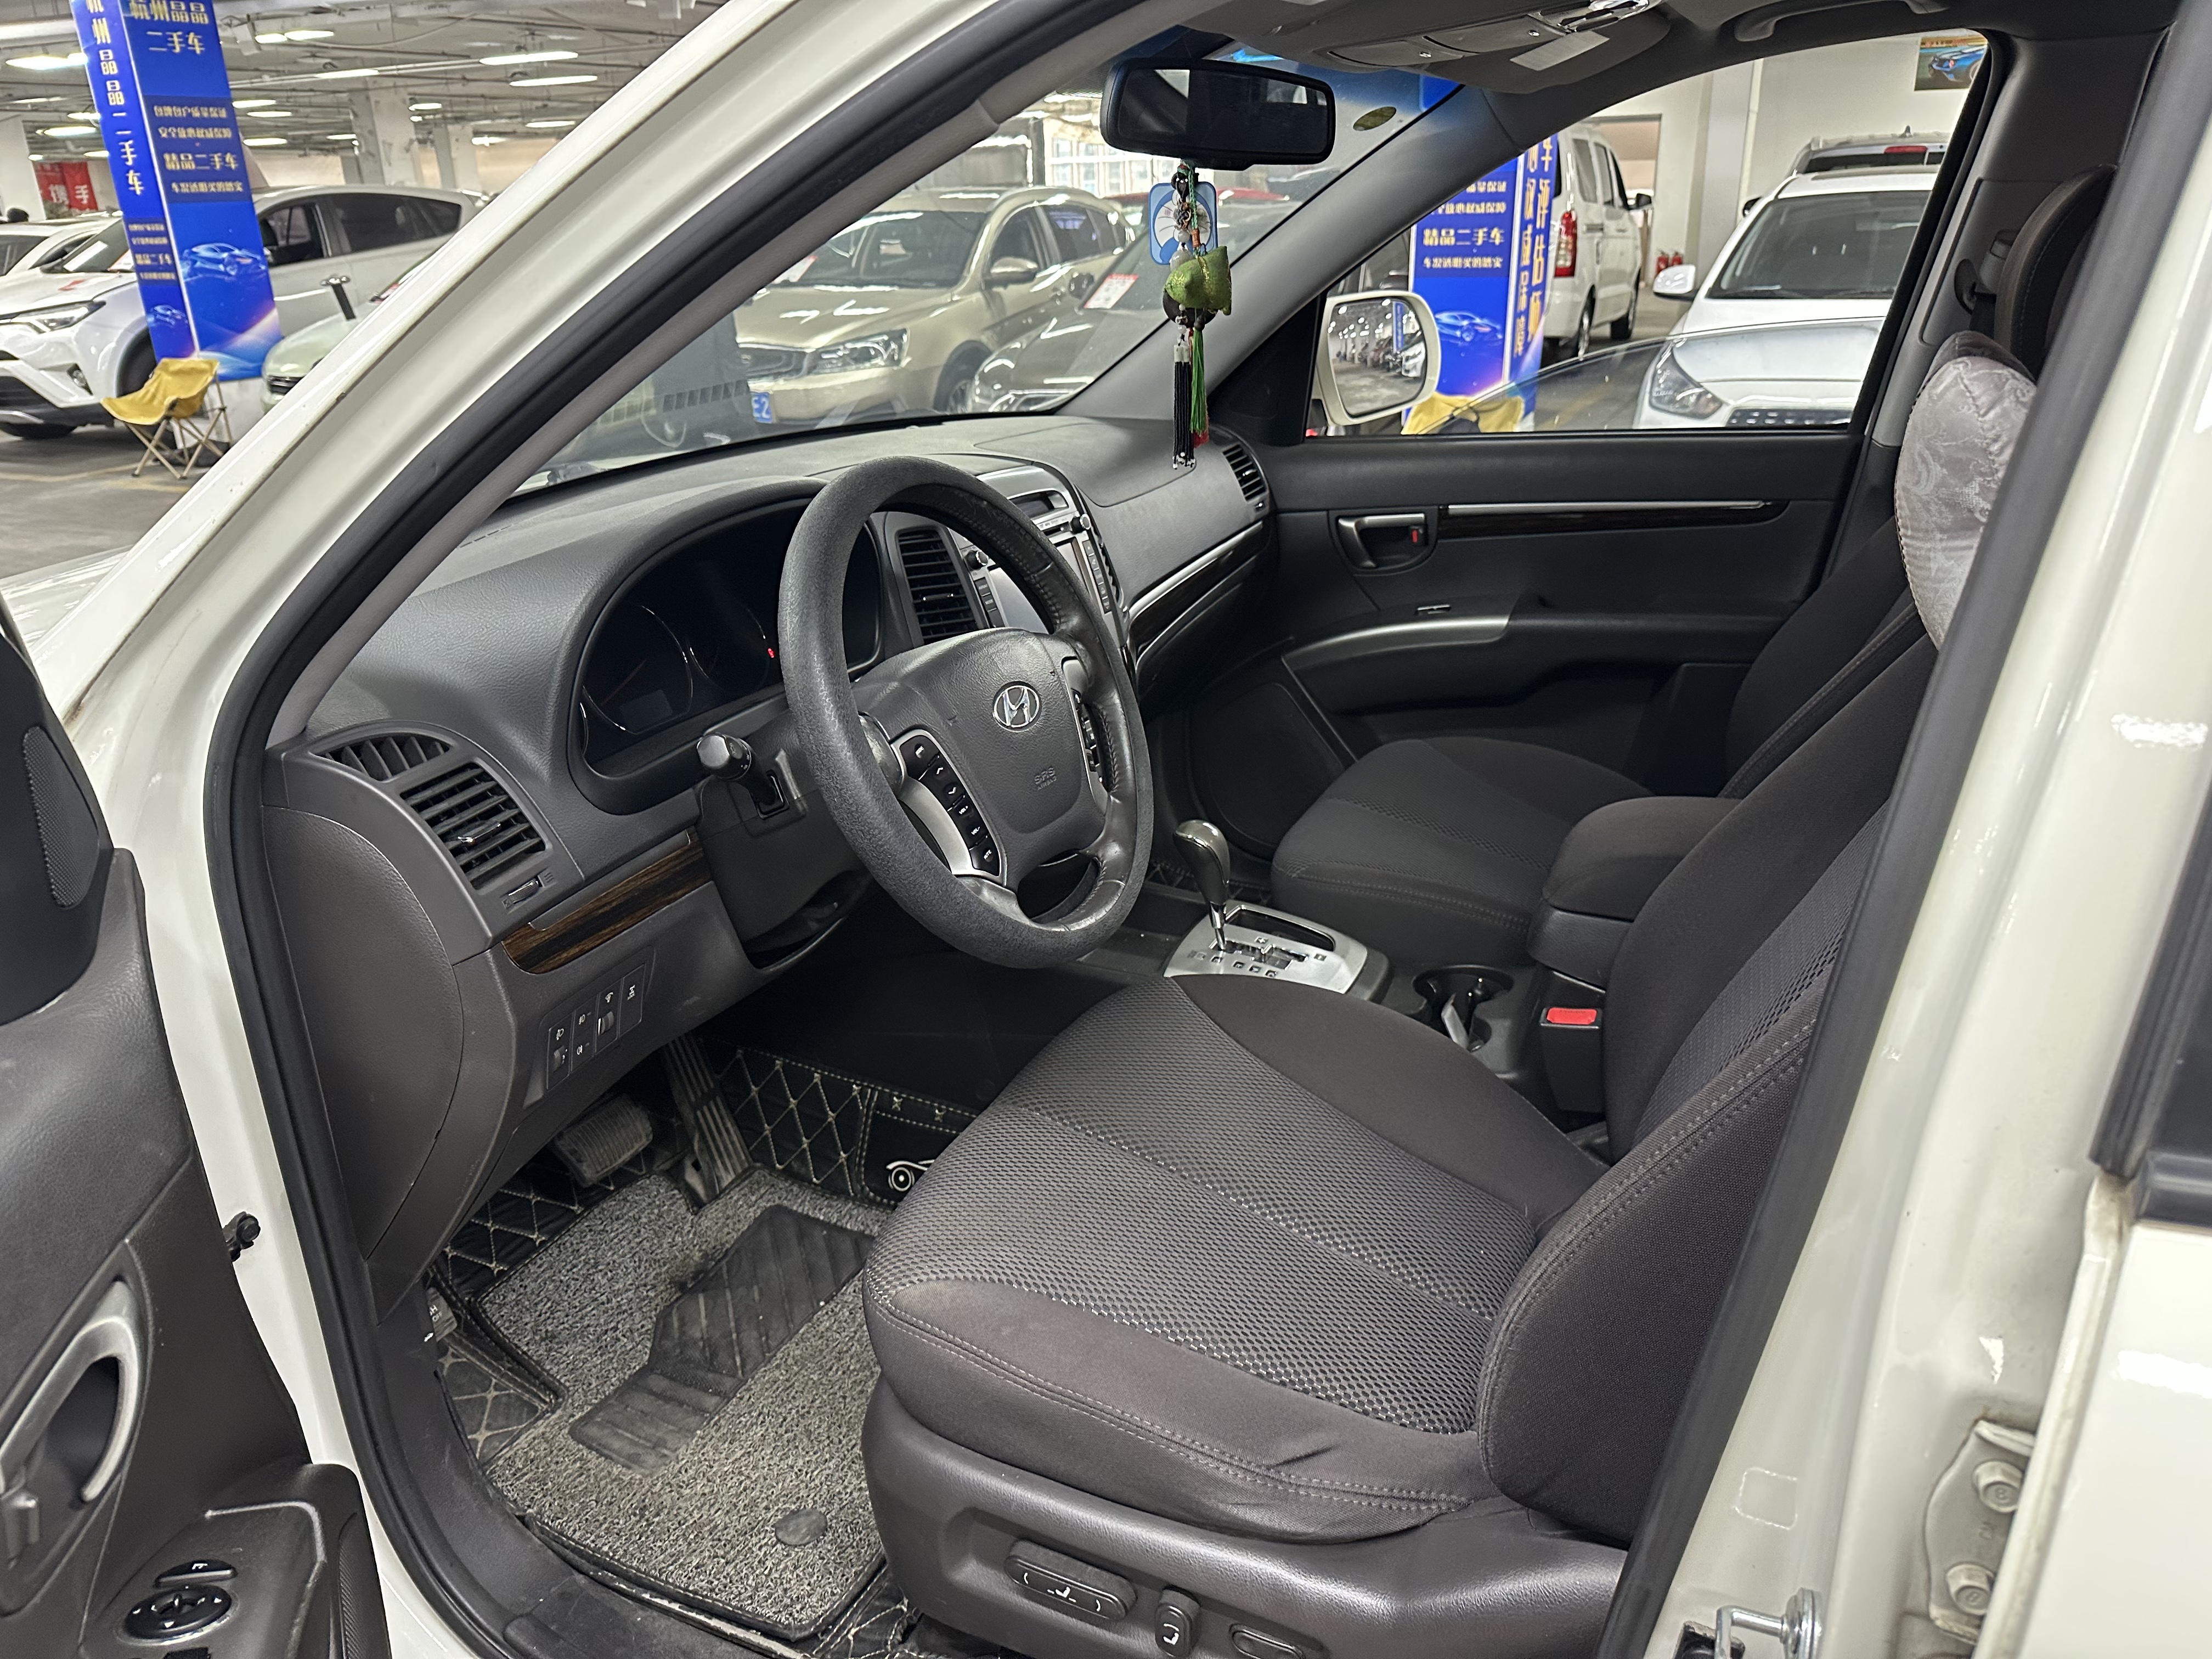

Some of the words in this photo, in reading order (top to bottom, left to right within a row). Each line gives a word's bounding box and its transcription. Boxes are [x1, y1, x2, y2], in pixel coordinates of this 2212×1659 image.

[130, 0, 209, 24] 杭州晶晶
[146, 31, 205, 54] 二手车
[163, 153, 238, 171] 精品二手车
[1423, 227, 1504, 246] 精品二手车
[1034, 768, 1055, 785] SRS
